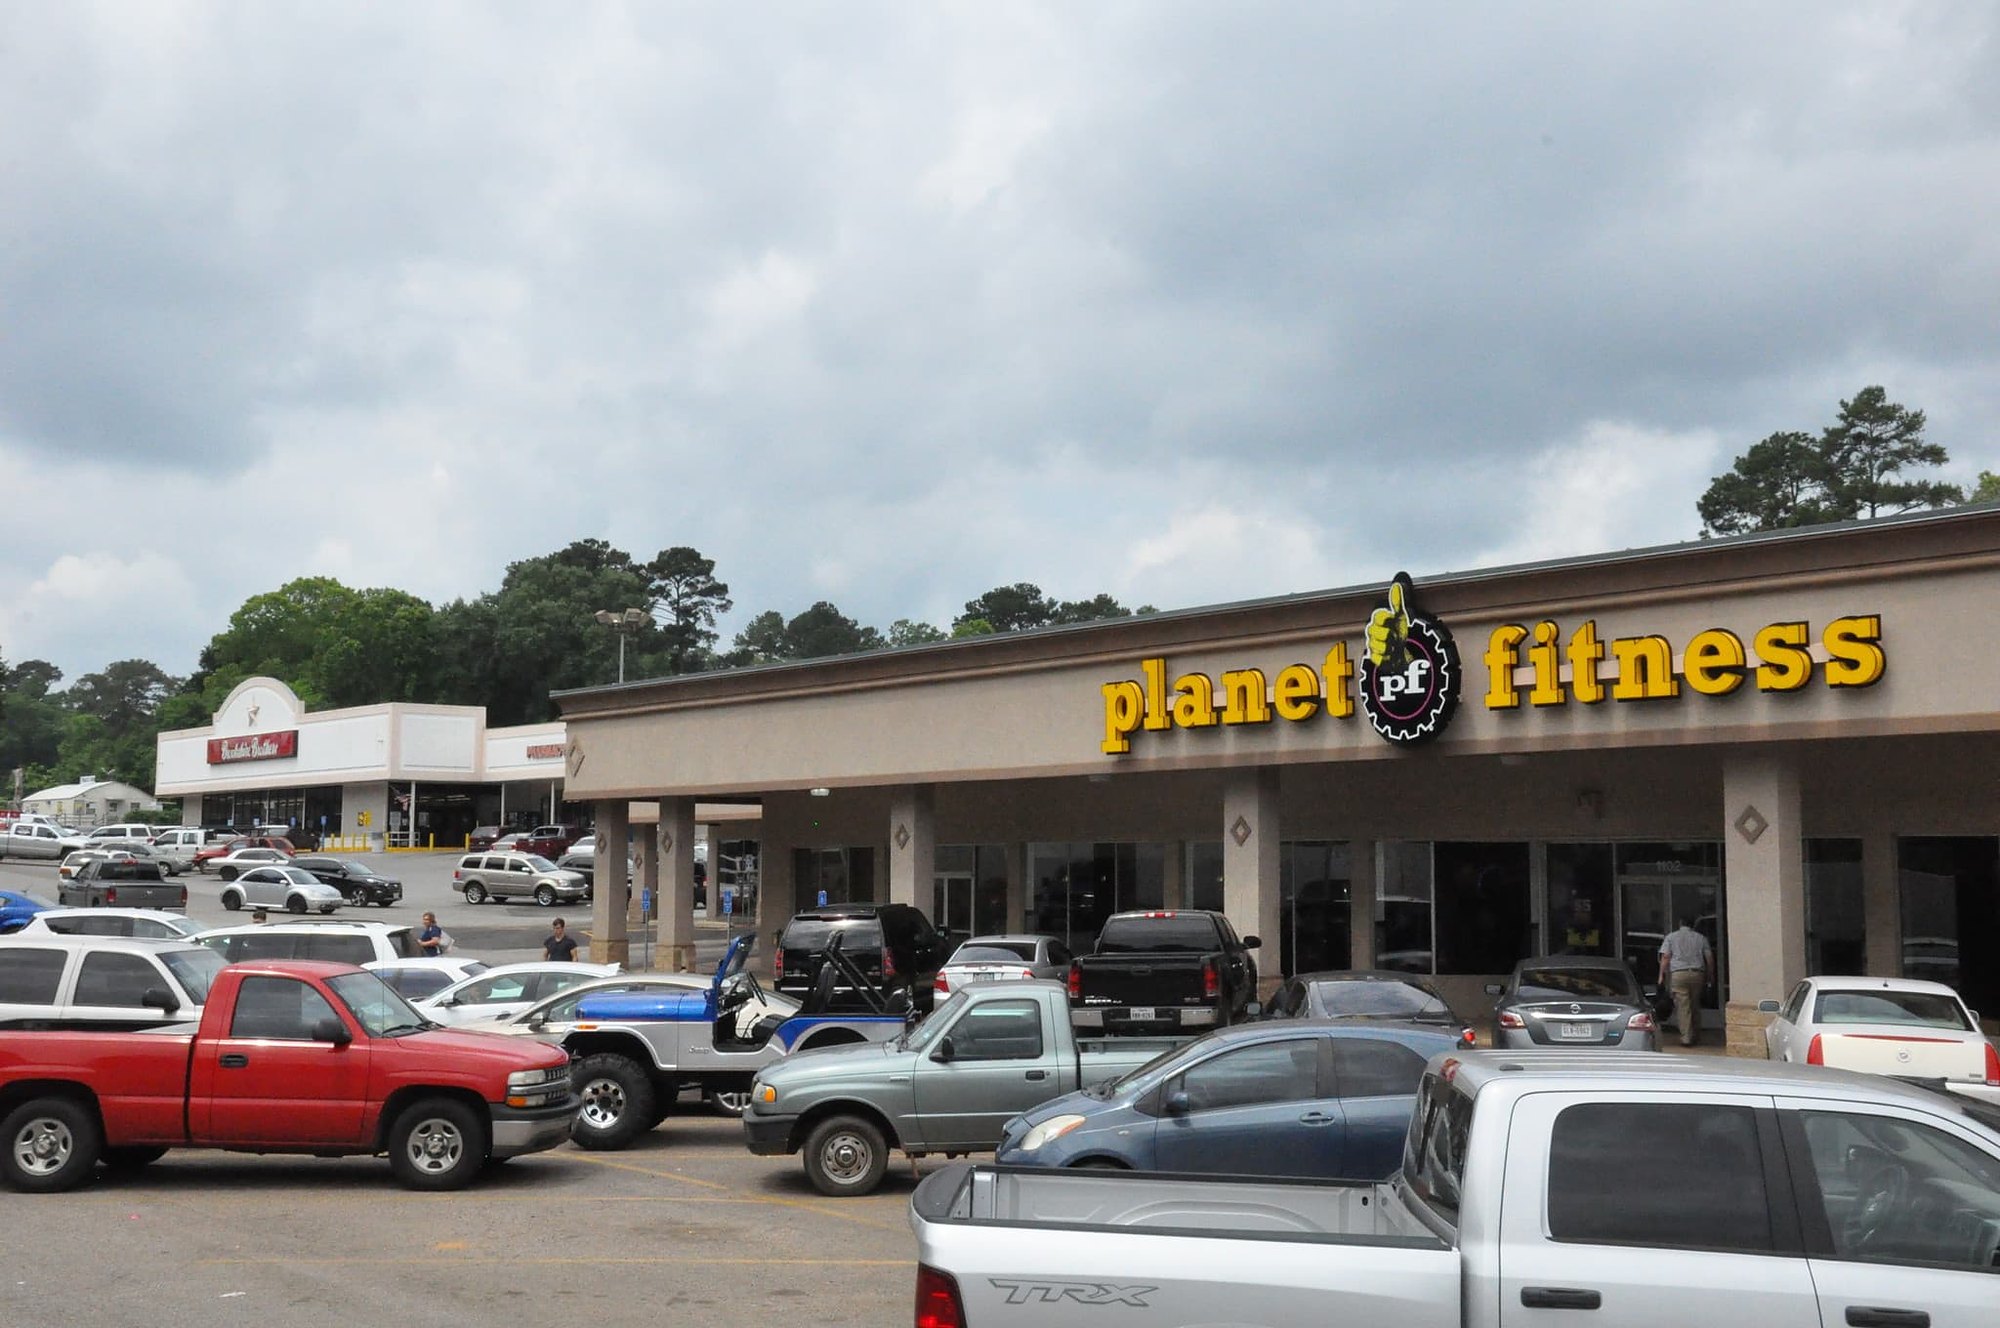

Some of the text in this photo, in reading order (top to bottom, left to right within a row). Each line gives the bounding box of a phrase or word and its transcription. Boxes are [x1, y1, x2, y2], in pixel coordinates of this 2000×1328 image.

[1101, 614, 1886, 754] planet fitness
[1379, 659, 1431, 701] pf
[988, 1278, 1160, 1307] TRX
